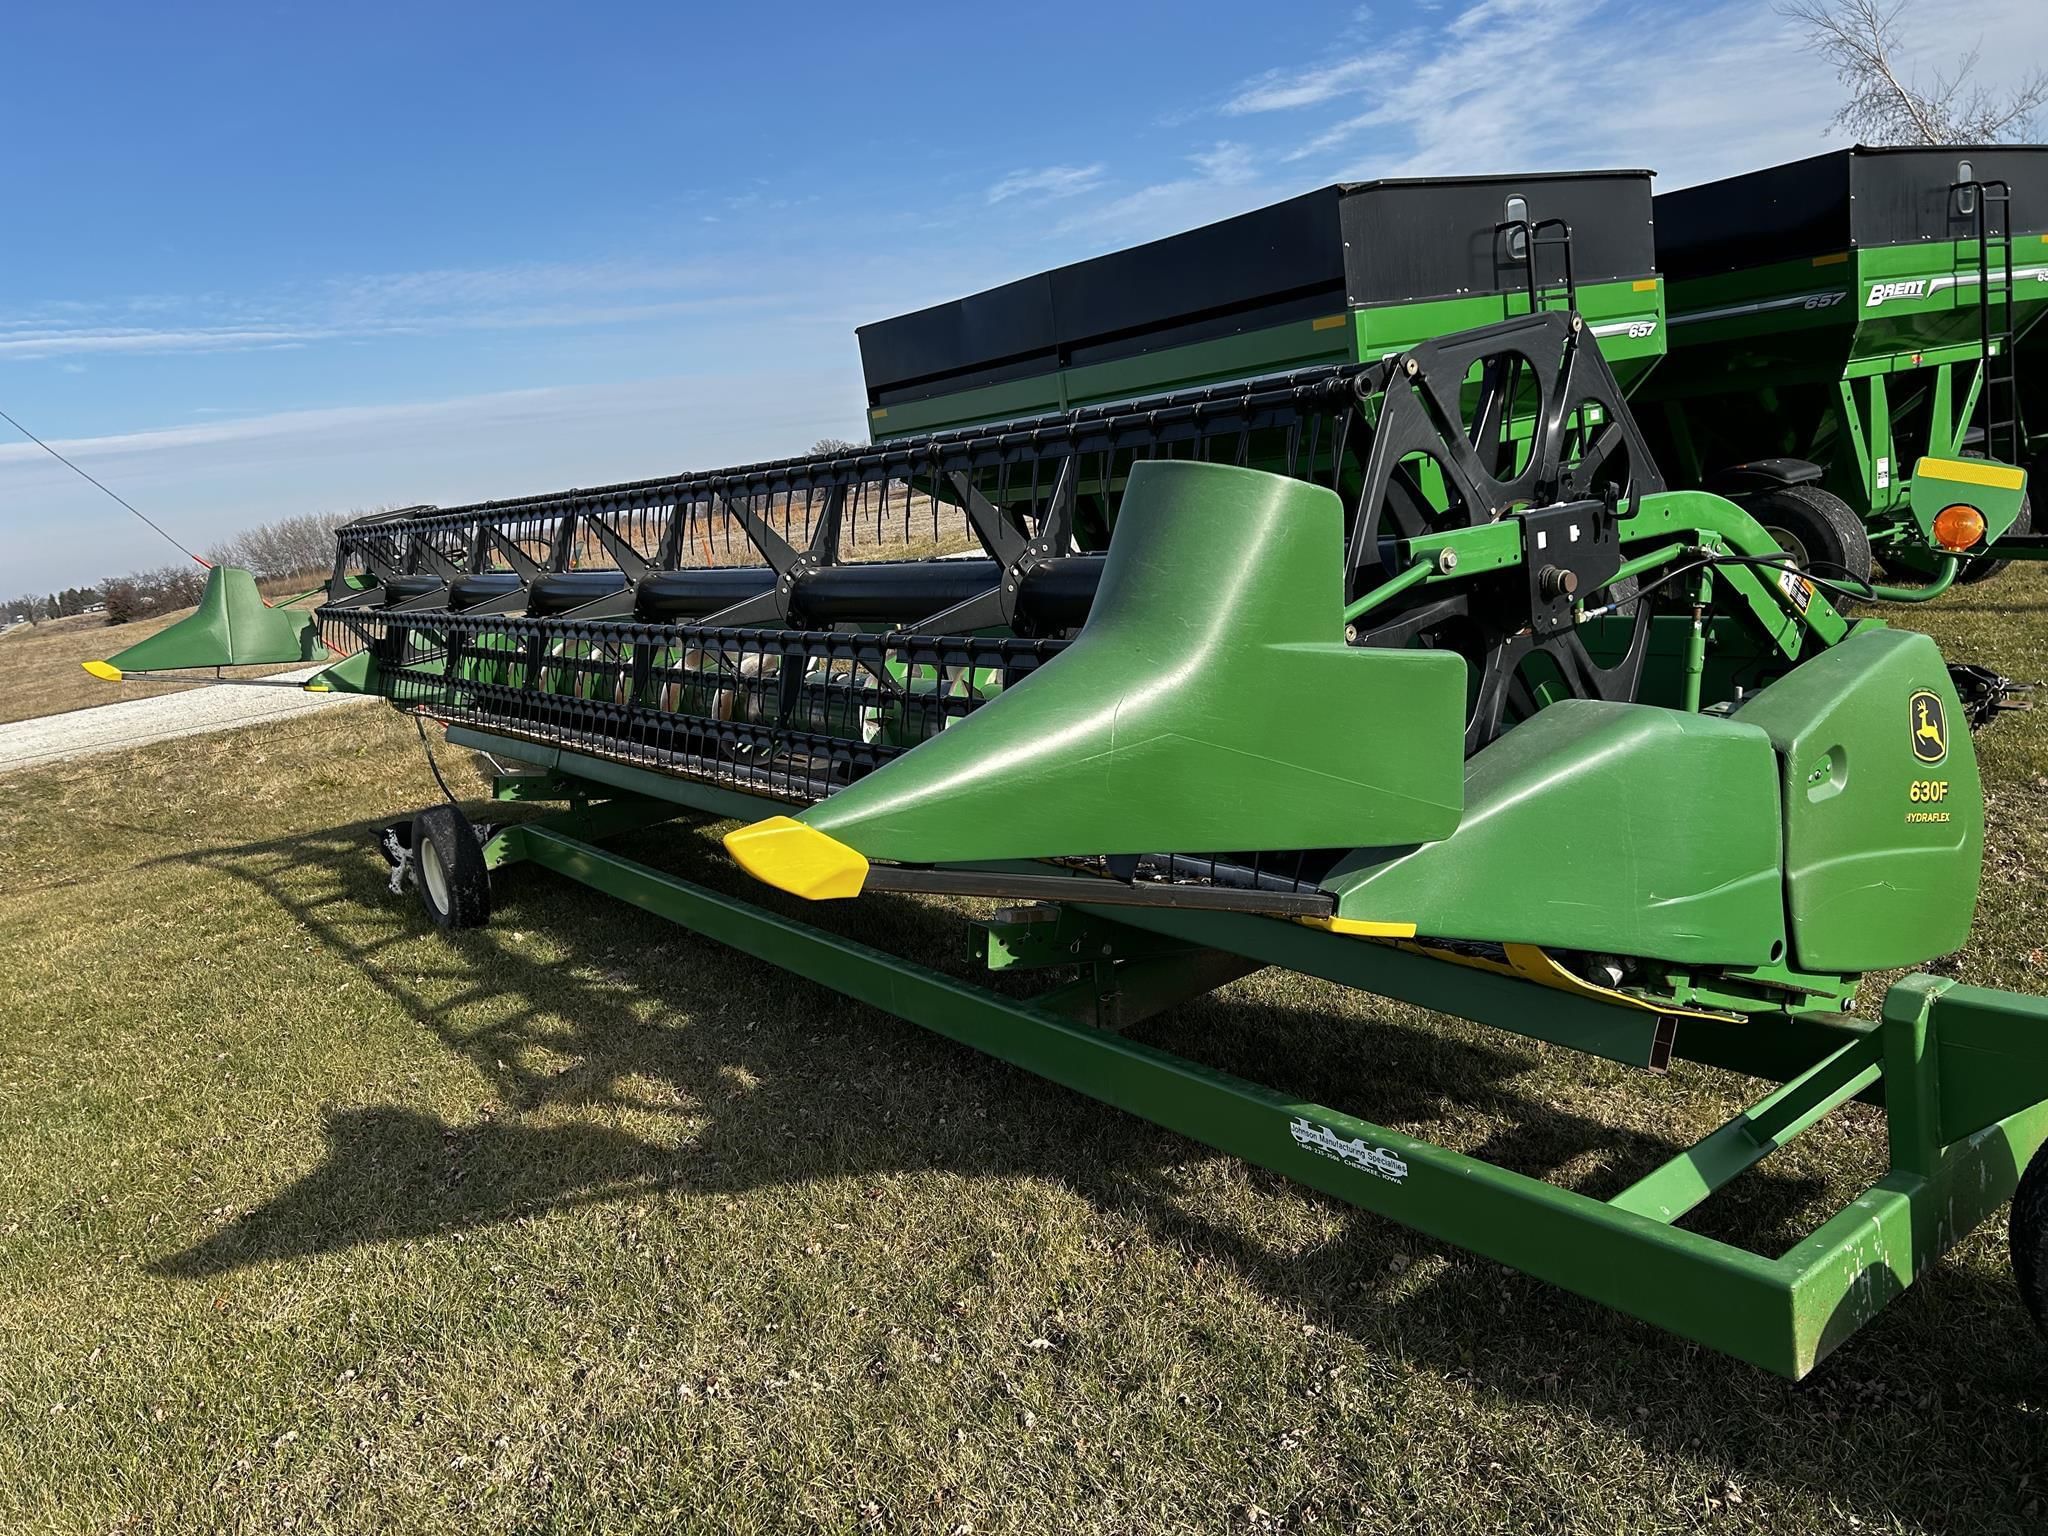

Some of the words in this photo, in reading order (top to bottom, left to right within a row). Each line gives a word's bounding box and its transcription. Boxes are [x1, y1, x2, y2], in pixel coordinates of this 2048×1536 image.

[1804, 291, 1848, 311] 657
[1866, 279, 1926, 307] BRENT
[1628, 321, 1657, 339] 657
[1909, 780, 1948, 803] 630F
[1905, 811, 1950, 823] HYDRAFLEX
[1292, 1123, 1318, 1141] Johnson
[1319, 1133, 1366, 1160] Manufacturing
[1367, 1151, 1407, 1173] Specialties
[1382, 1173, 1402, 1185] IOWA
